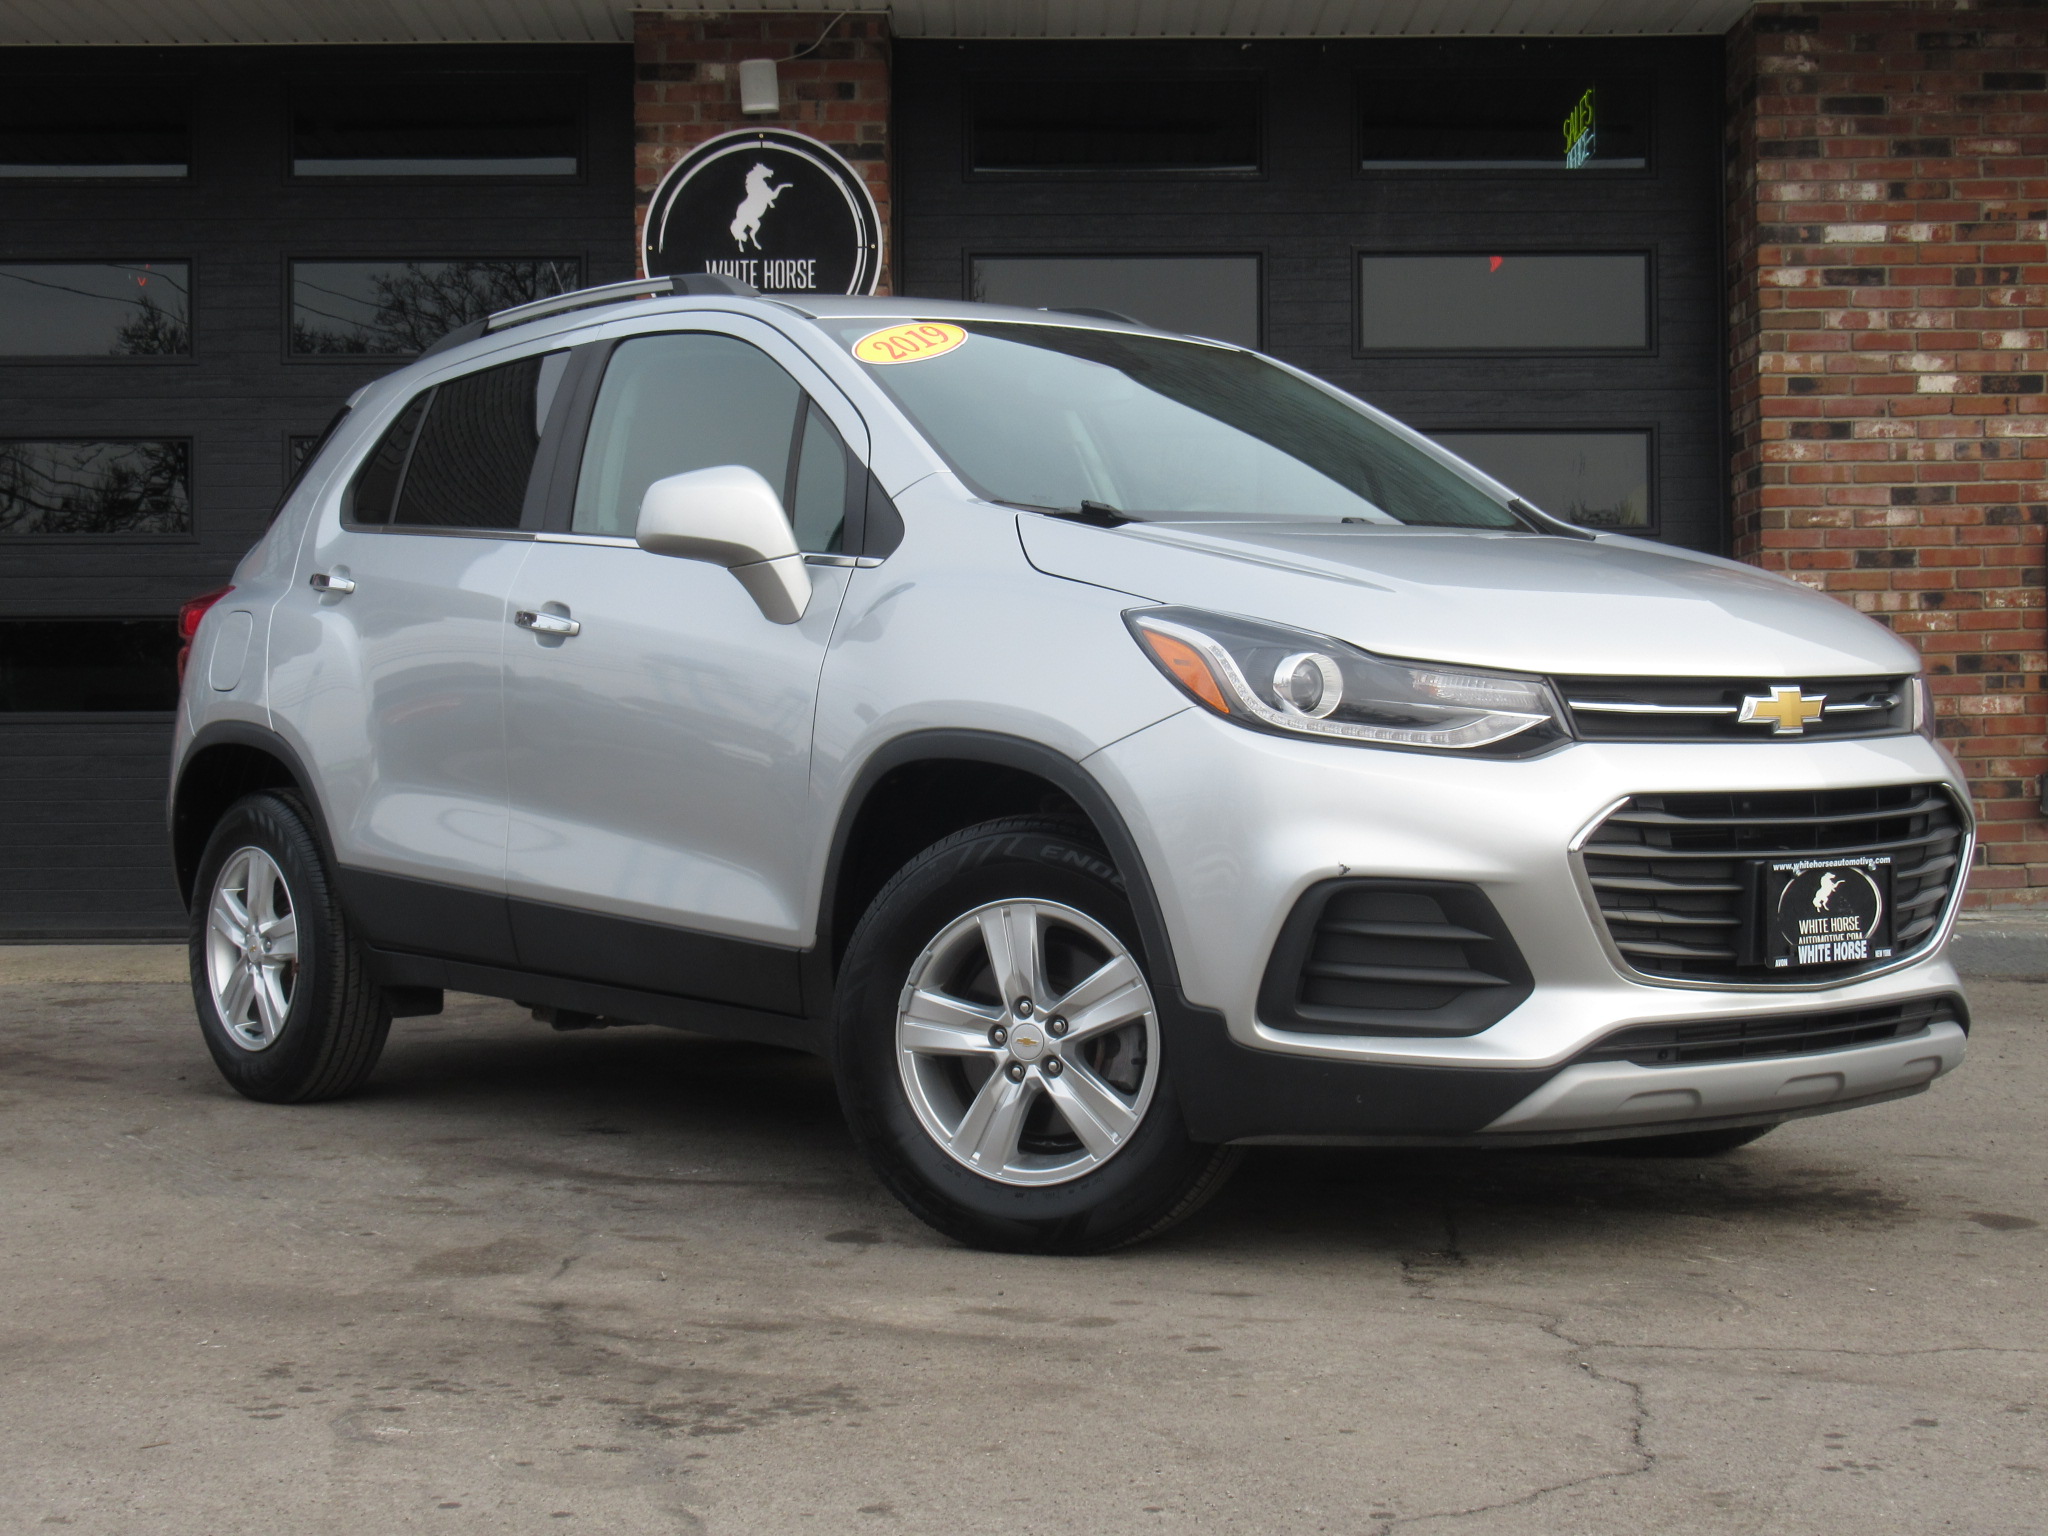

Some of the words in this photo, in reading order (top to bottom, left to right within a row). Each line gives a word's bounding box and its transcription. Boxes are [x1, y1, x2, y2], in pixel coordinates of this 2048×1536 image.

[1563, 89, 1592, 154] SALES
[764, 259, 816, 289] HORSE
[872, 325, 949, 360] 2019
[1773, 856, 1891, 872] www.whitehorseautomotive.com
[1798, 918, 1829, 935] WHITE
[1830, 915, 1861, 932] HORSE
[1774, 958, 1788, 967] AVON
[1798, 943, 1831, 965] WHITE
[1833, 940, 1868, 961] HORSE
